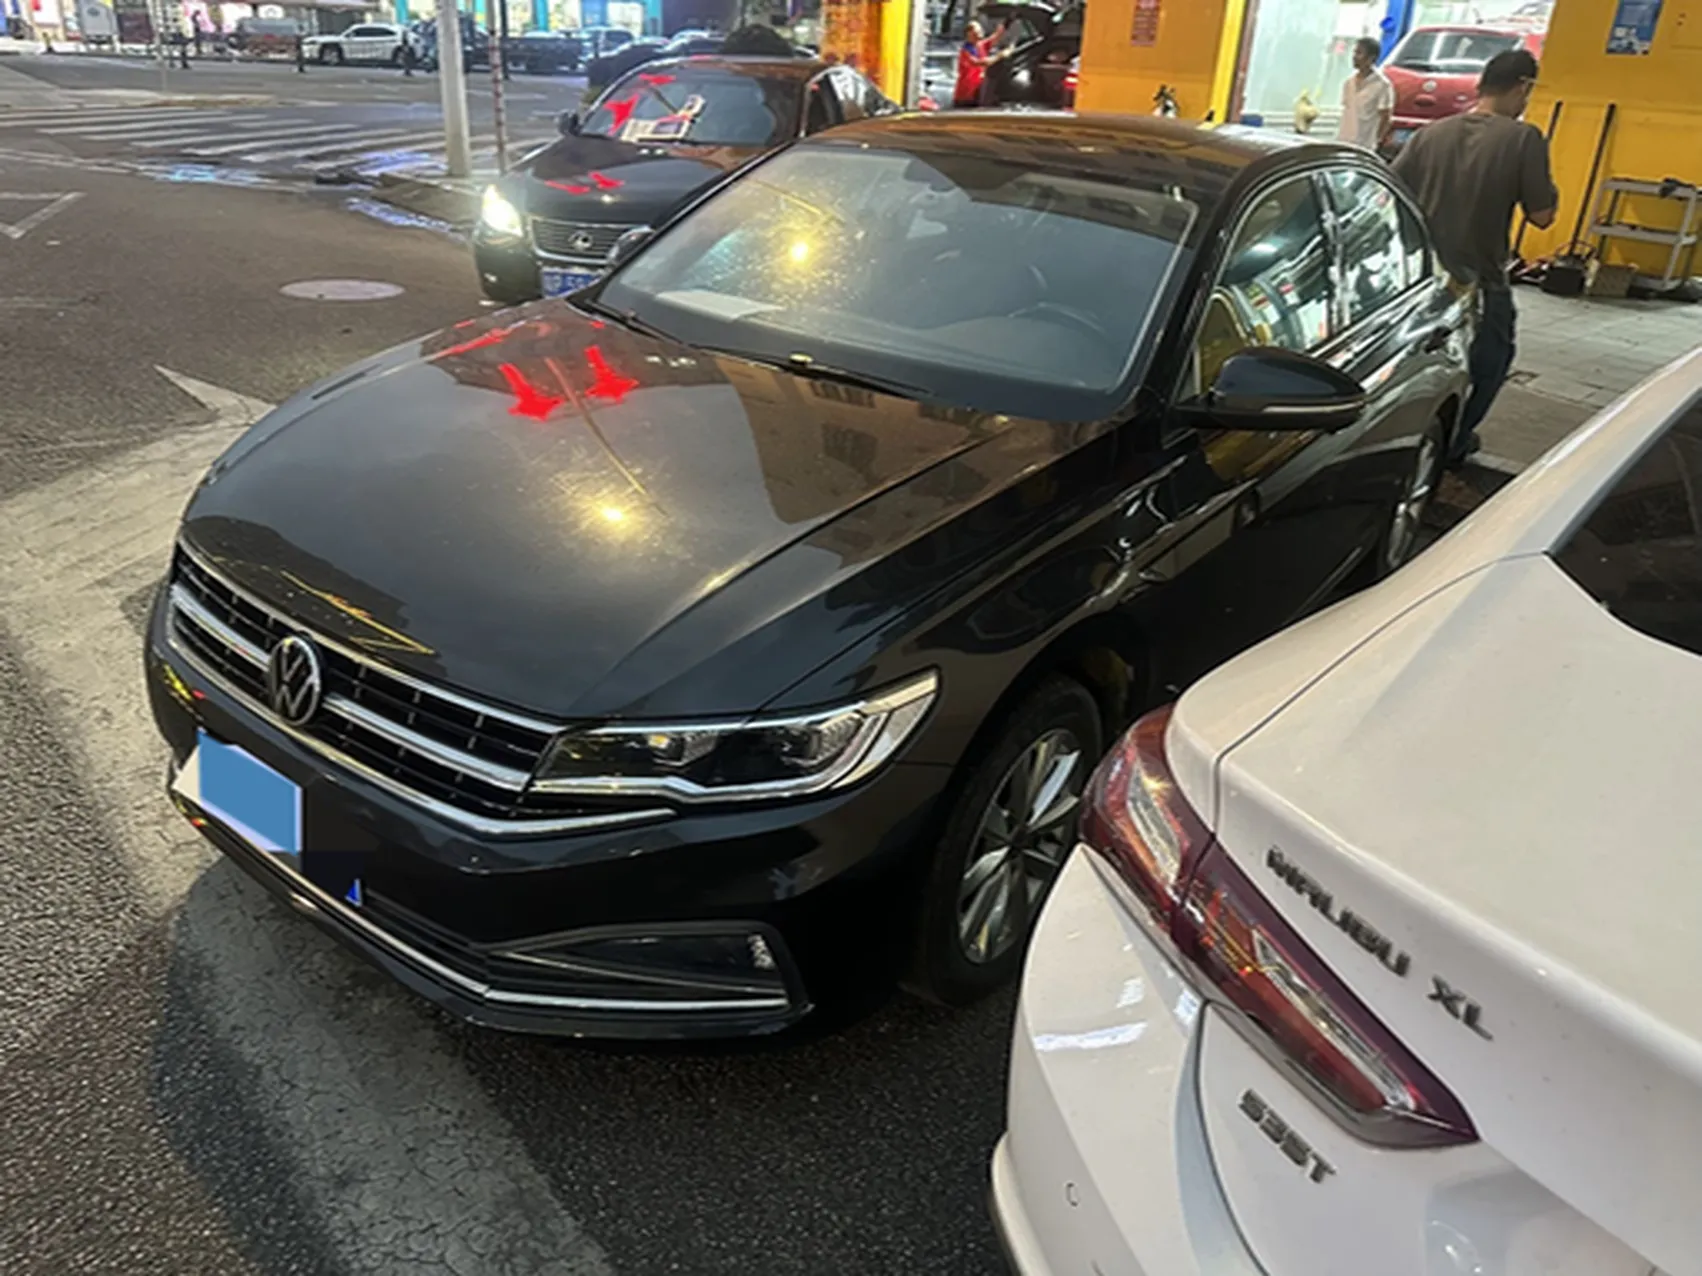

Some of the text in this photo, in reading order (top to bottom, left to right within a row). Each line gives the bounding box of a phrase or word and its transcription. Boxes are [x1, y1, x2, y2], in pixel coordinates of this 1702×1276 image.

[1266, 846, 1494, 1041] MALIBU XL
[1238, 1088, 1337, 1184] 535T
